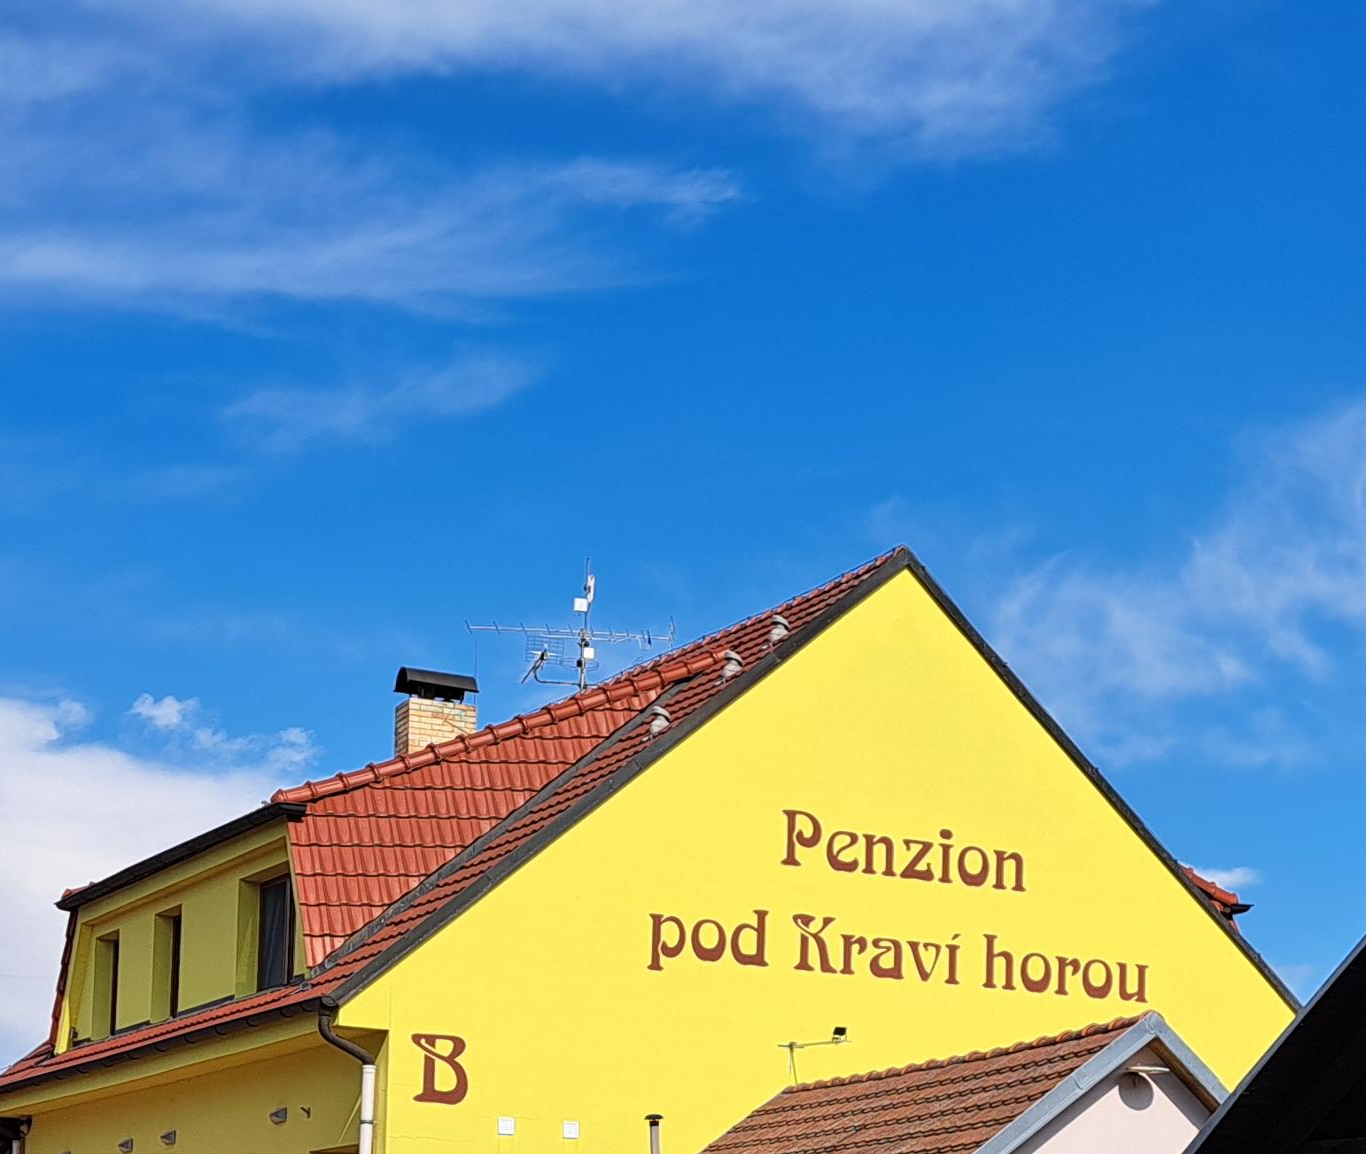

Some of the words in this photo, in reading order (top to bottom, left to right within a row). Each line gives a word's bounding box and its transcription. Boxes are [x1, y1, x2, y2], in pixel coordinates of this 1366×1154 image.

[781, 809, 1027, 892] Penzion
[647, 910, 769, 971] pod
[792, 913, 961, 985] Kraví
[982, 934, 1150, 1003] horou
[411, 1033, 468, 1105] B
